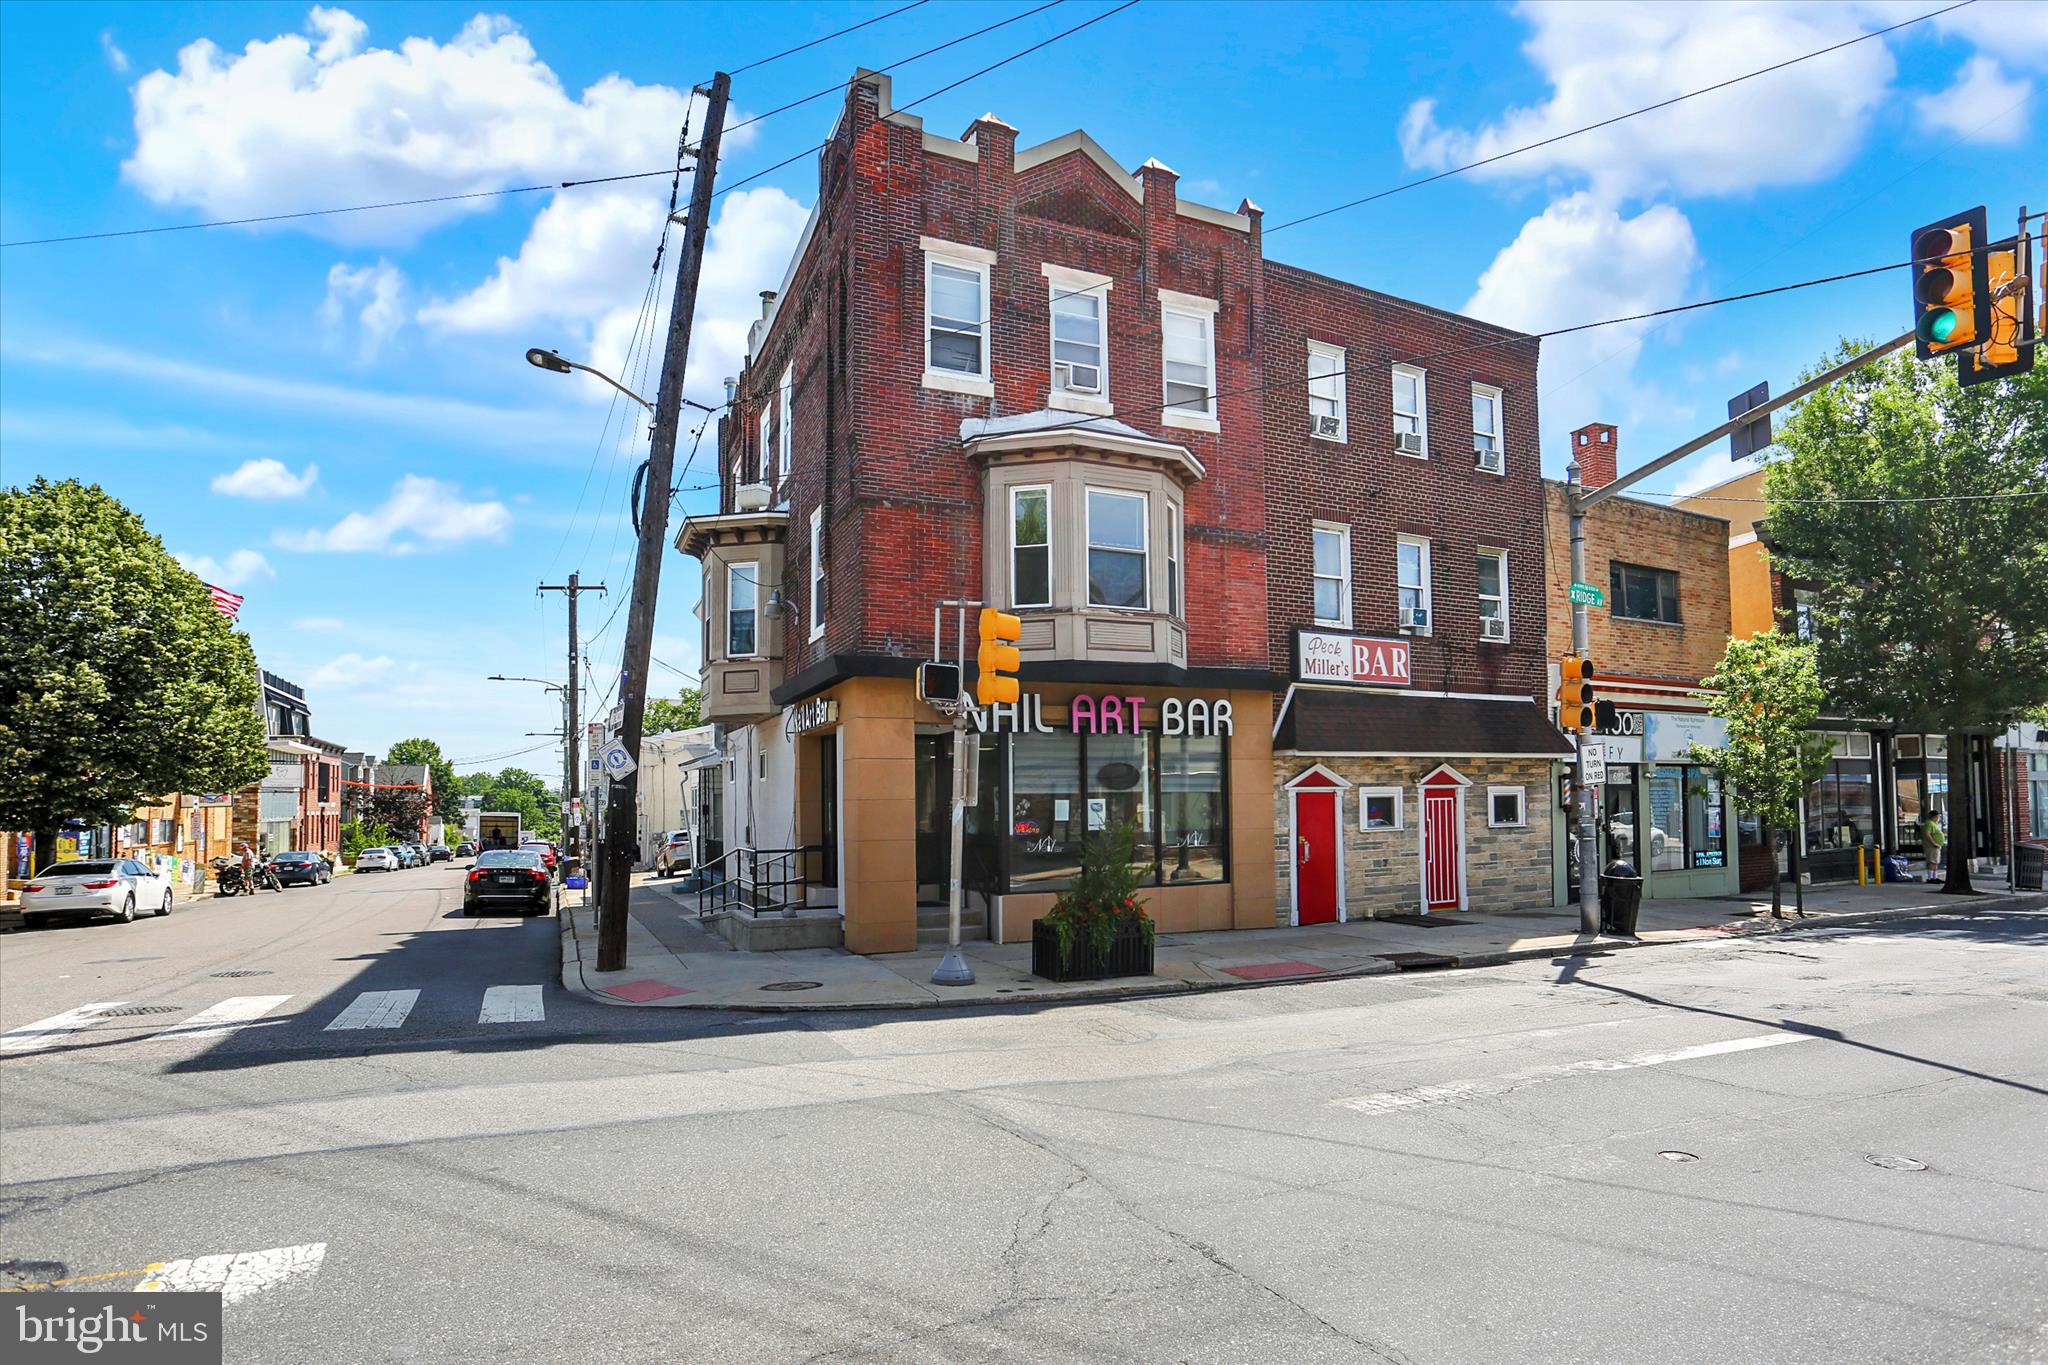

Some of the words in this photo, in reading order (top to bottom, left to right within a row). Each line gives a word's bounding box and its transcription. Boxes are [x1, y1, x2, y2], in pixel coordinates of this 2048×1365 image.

[1576, 590, 1595, 605] RIDGE
[1308, 637, 1342, 656] Peck
[1305, 657, 1349, 677] Miller's
[1353, 644, 1408, 678] BAR
[1072, 694, 1146, 734] ART
[1162, 697, 1233, 736] BAR
[1588, 748, 1597, 757] NO
[1585, 760, 1602, 768] TURN
[1585, 772, 1593, 781] ON
[1594, 770, 1604, 779] RED
